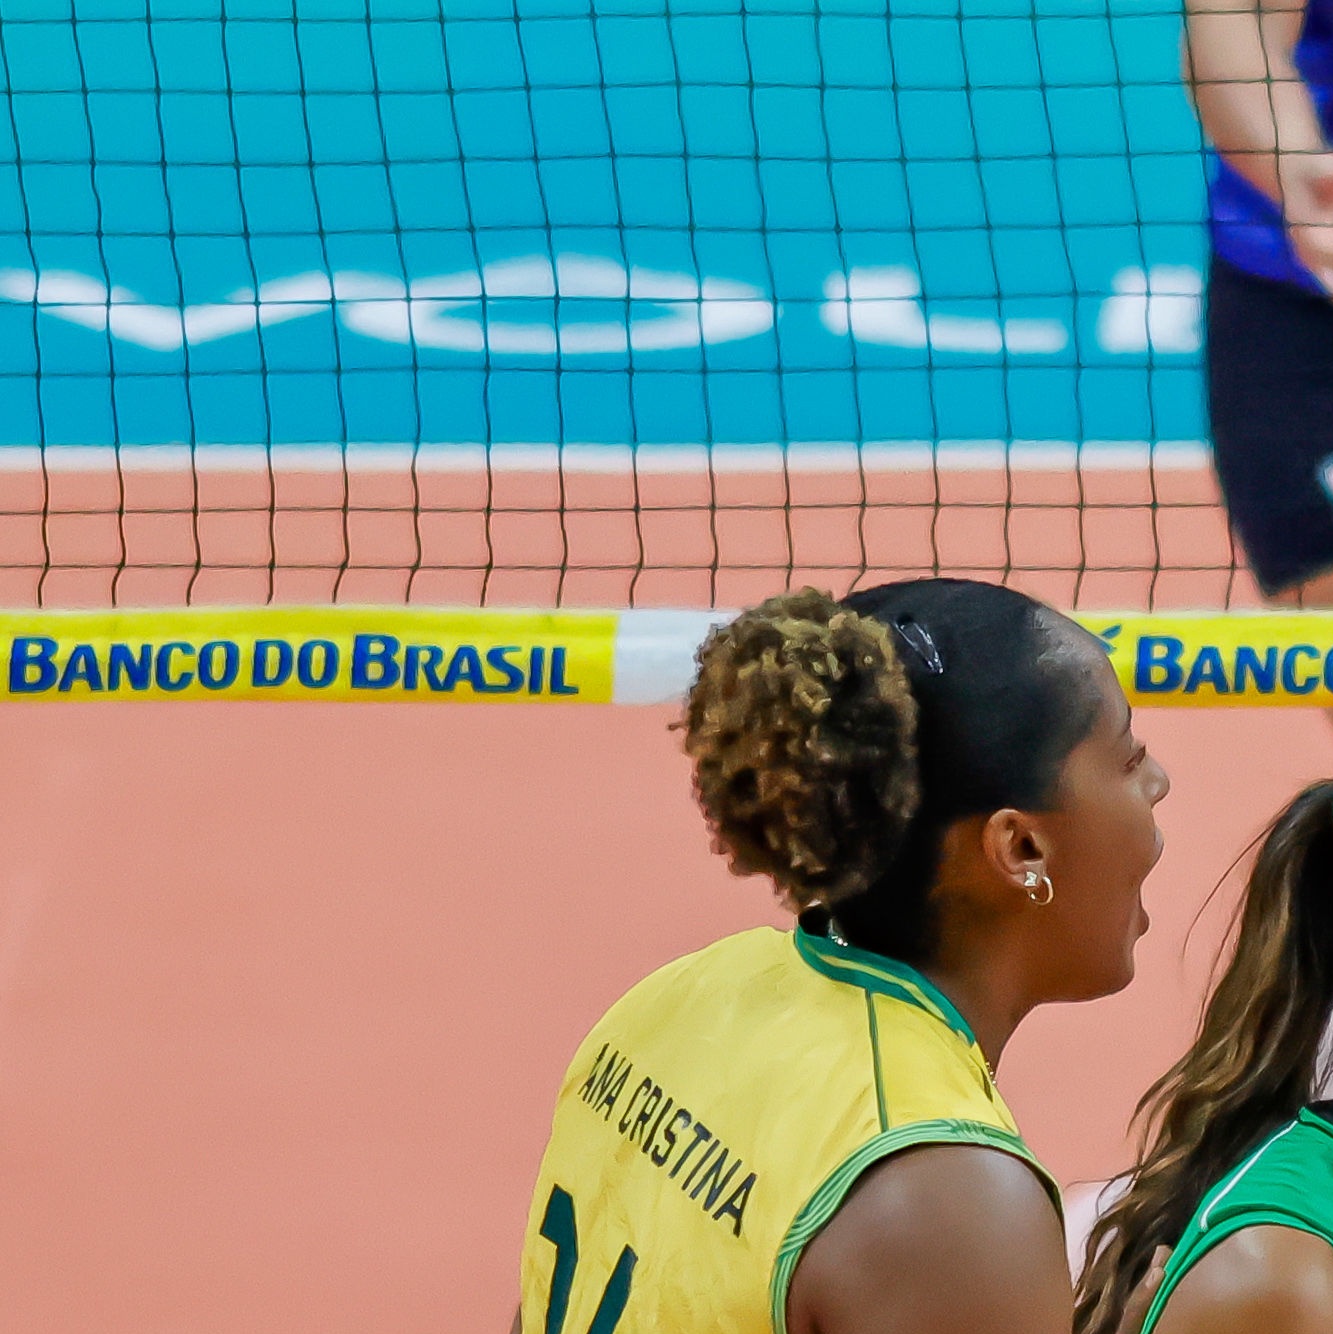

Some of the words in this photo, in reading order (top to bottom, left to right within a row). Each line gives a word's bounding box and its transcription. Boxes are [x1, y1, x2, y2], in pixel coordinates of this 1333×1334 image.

[9, 636, 239, 694] BANCO
[252, 639, 339, 690] DO
[351, 634, 579, 695] BRASIL
[577, 1042, 634, 1122] ANA
[618, 1076, 758, 1238] CRISTINA
